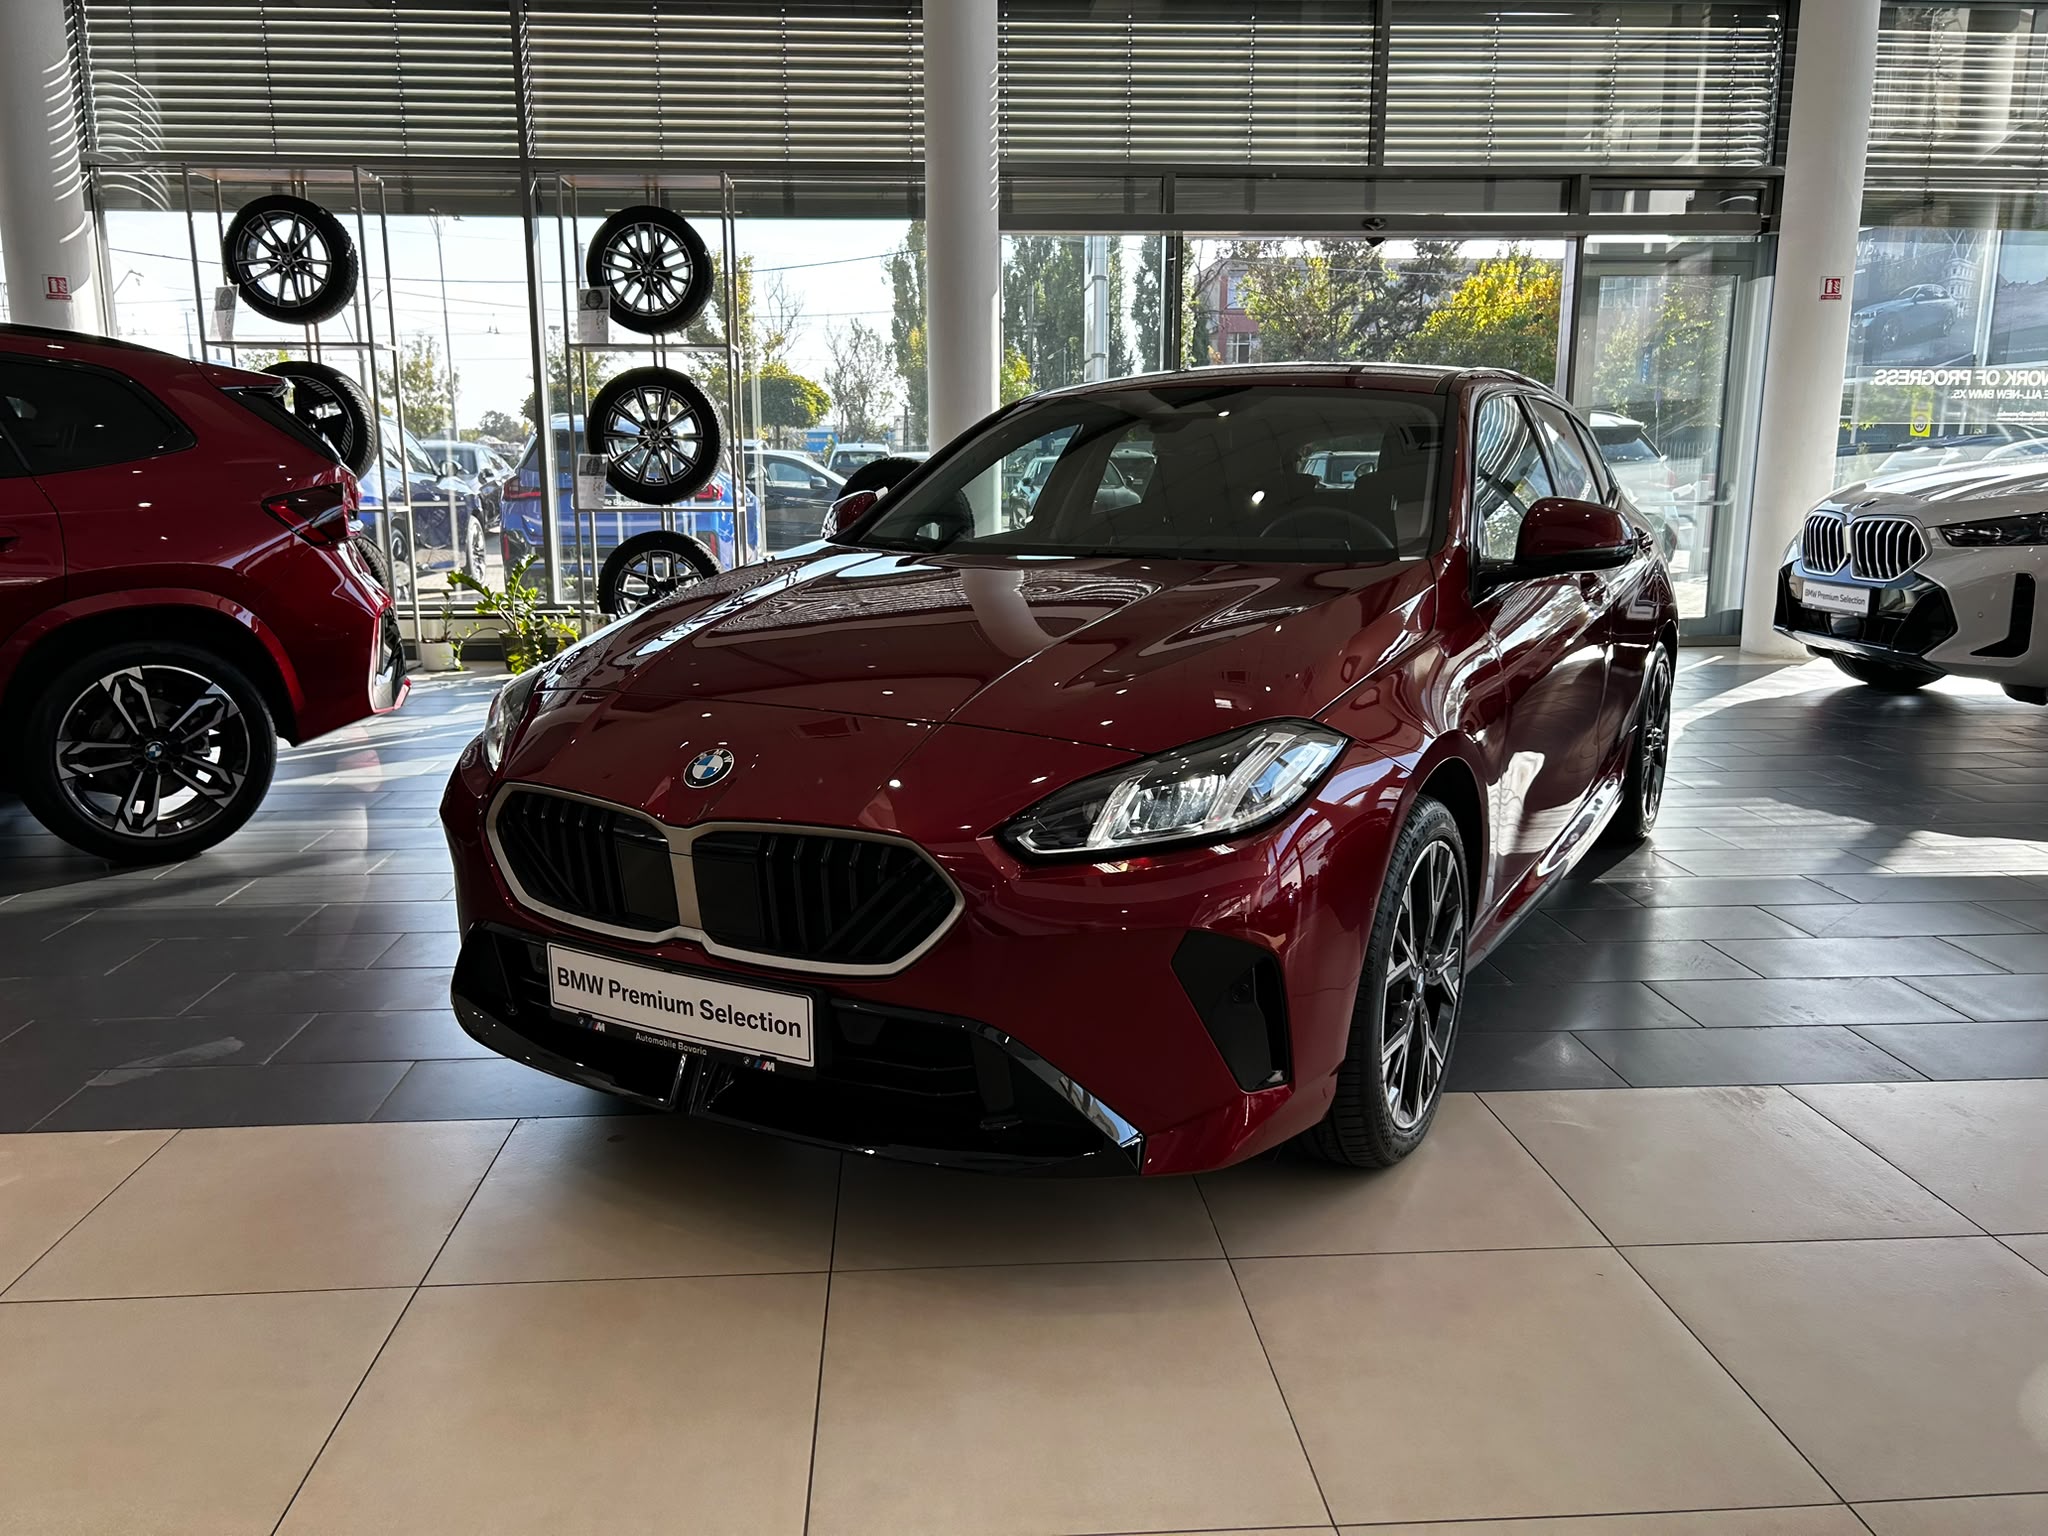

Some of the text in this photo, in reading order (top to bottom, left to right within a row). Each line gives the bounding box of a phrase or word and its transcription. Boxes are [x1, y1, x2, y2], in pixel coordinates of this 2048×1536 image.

[1840, 594, 1866, 605] Selection
[557, 966, 802, 1039] BMW Premium Selection
[635, 1032, 708, 1056] Automobile Bavaria
